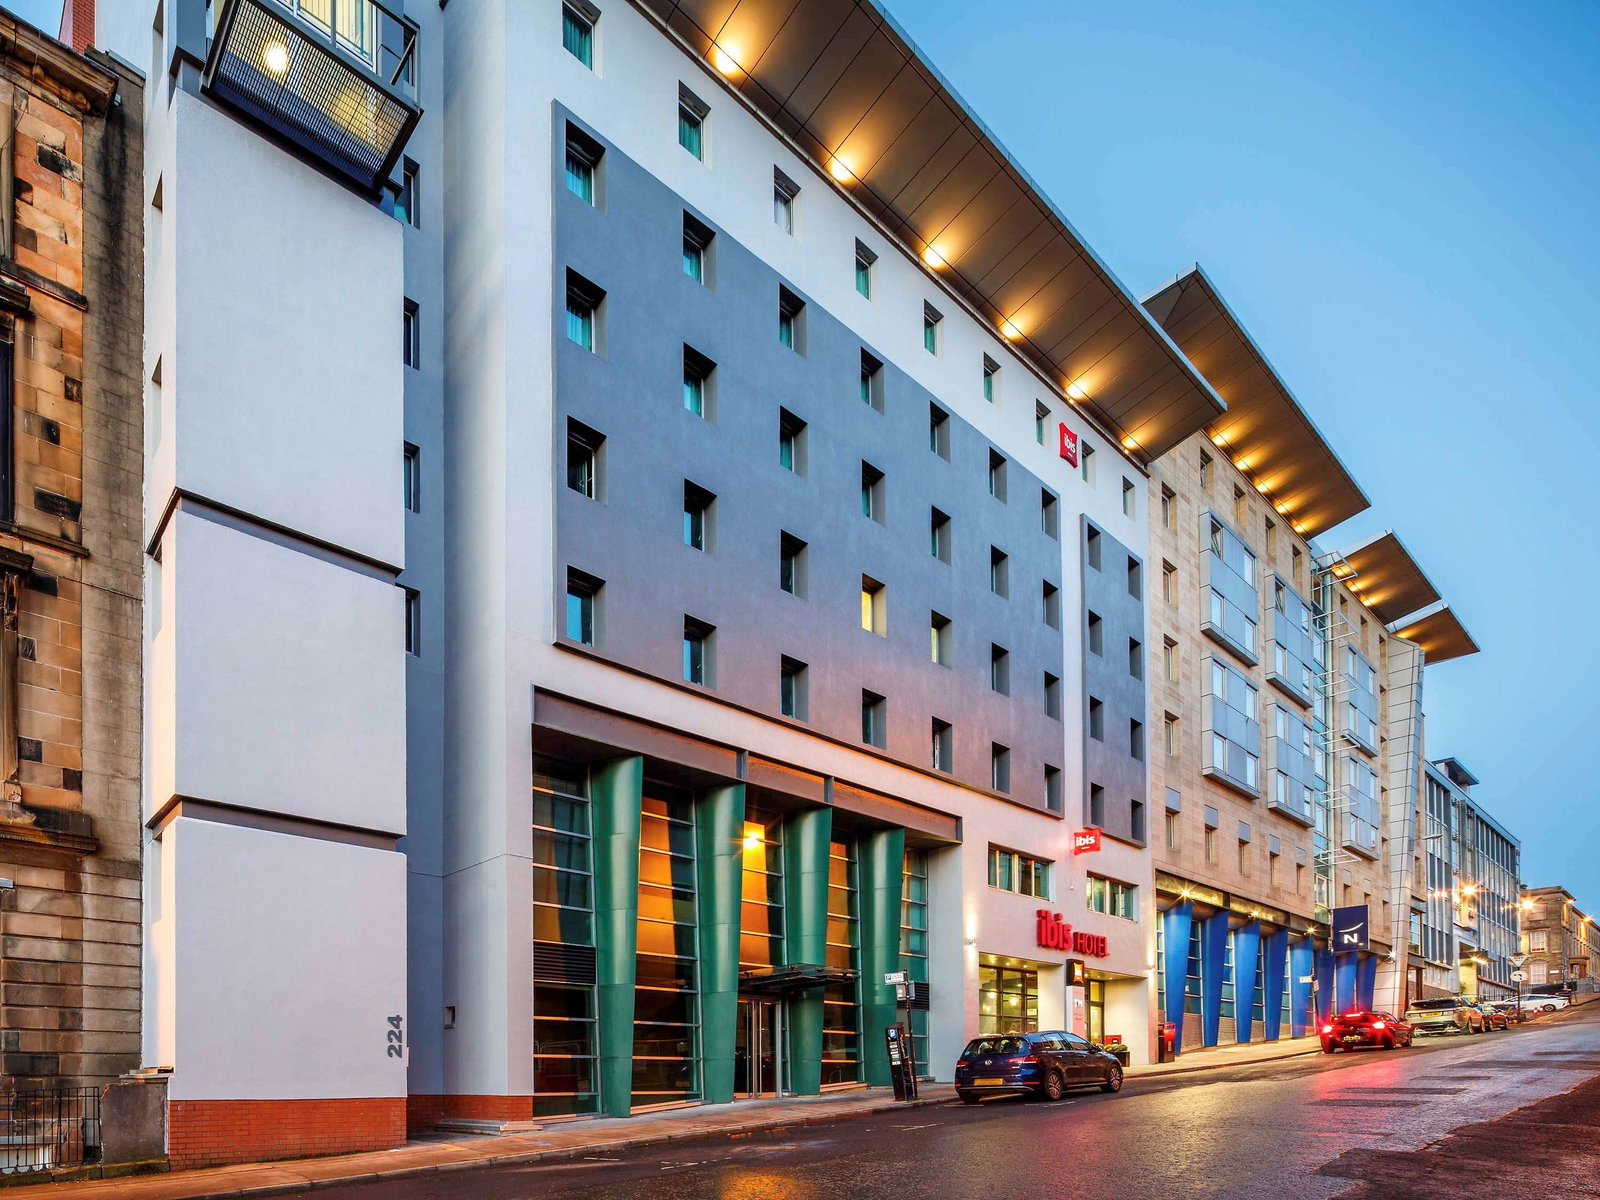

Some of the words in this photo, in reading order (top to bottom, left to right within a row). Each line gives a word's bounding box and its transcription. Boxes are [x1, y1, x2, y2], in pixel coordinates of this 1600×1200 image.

[1064, 433, 1075, 453] ibis
[1076, 835, 1095, 846] ibis
[1036, 909, 1072, 950] ibis
[1073, 931, 1110, 957] HOTEL
[1344, 933, 1358, 944] N
[387, 1014, 403, 1058] 224
